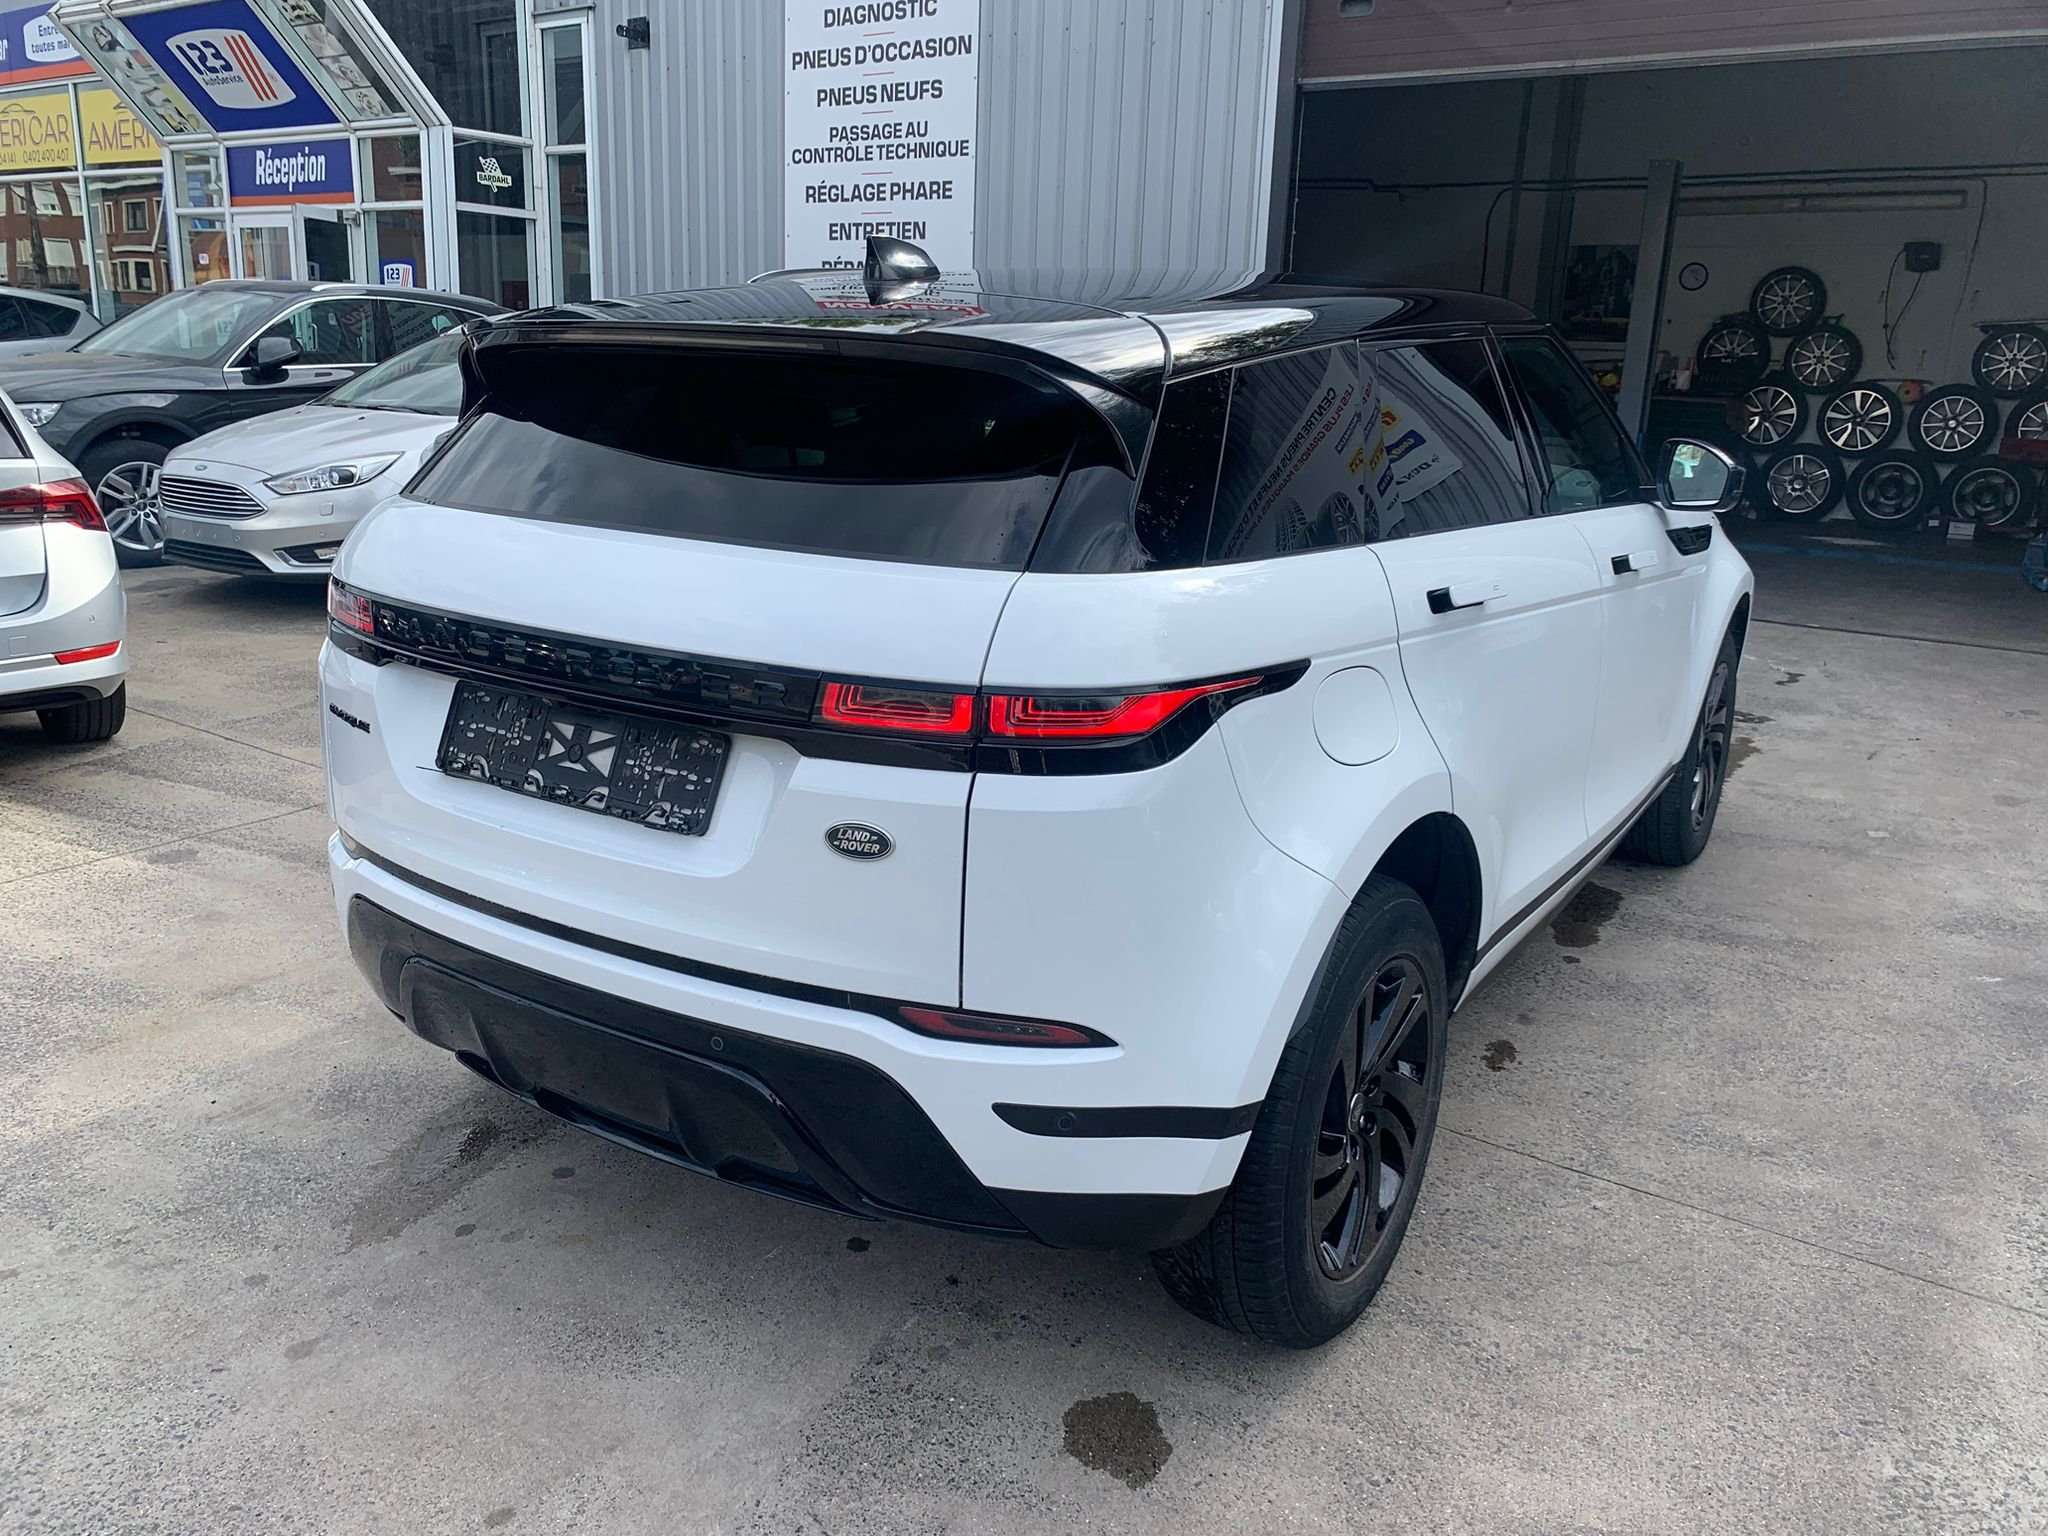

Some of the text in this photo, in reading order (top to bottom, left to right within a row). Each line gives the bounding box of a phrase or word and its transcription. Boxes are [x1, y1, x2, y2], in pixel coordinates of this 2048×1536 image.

[824, 0, 938, 28] DIAGNOSTIC
[31, 41, 55, 54] toutes
[792, 34, 972, 71] PNEUS D'OCCASION
[817, 79, 943, 107] PNEUS NEUFS
[829, 120, 928, 143] PASSAGE AU
[792, 139, 969, 164] CONTRÔLE TECHNIQUE
[255, 146, 326, 192] Réception
[478, 174, 511, 184] BARDAHL
[805, 180, 953, 203] RÉGLAGE PHARE
[828, 221, 927, 241] ENTRETIEN
[837, 829, 870, 842] LAND
[840, 840, 880, 853] ROVER
